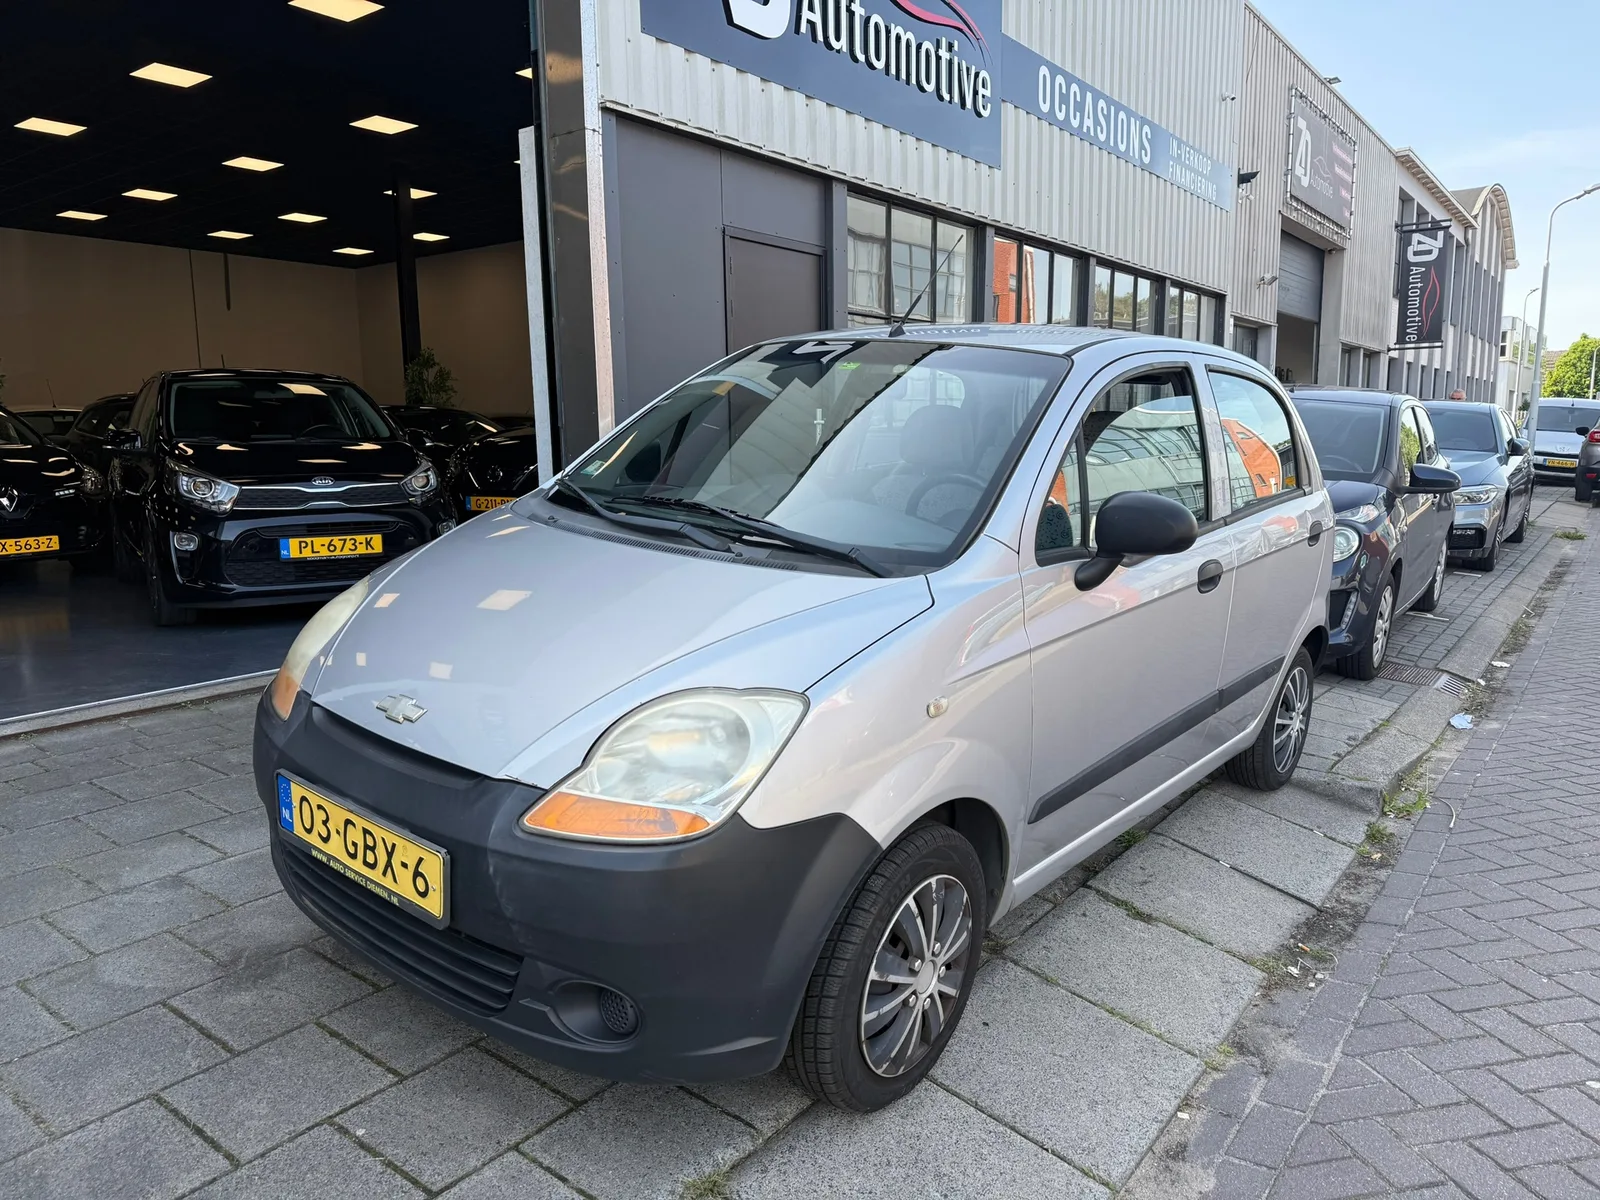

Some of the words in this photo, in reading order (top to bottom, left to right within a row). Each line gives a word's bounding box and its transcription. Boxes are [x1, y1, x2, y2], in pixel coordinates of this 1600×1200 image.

[799, 0, 992, 118] Automotive
[1038, 65, 1151, 164] OCCASIONS
[1169, 136, 1212, 176] IN-VERKOOP
[1169, 160, 1217, 201] FINANCIERING
[1405, 266, 1426, 342] Automotive
[0, 537, 54, 553] X-563-Z
[298, 537, 376, 554] PL-673-K
[282, 807, 293, 823] NL
[299, 795, 430, 899] 03-GBX-6
[330, 859, 345, 873] AUTO
[345, 868, 367, 887] SERVICE
